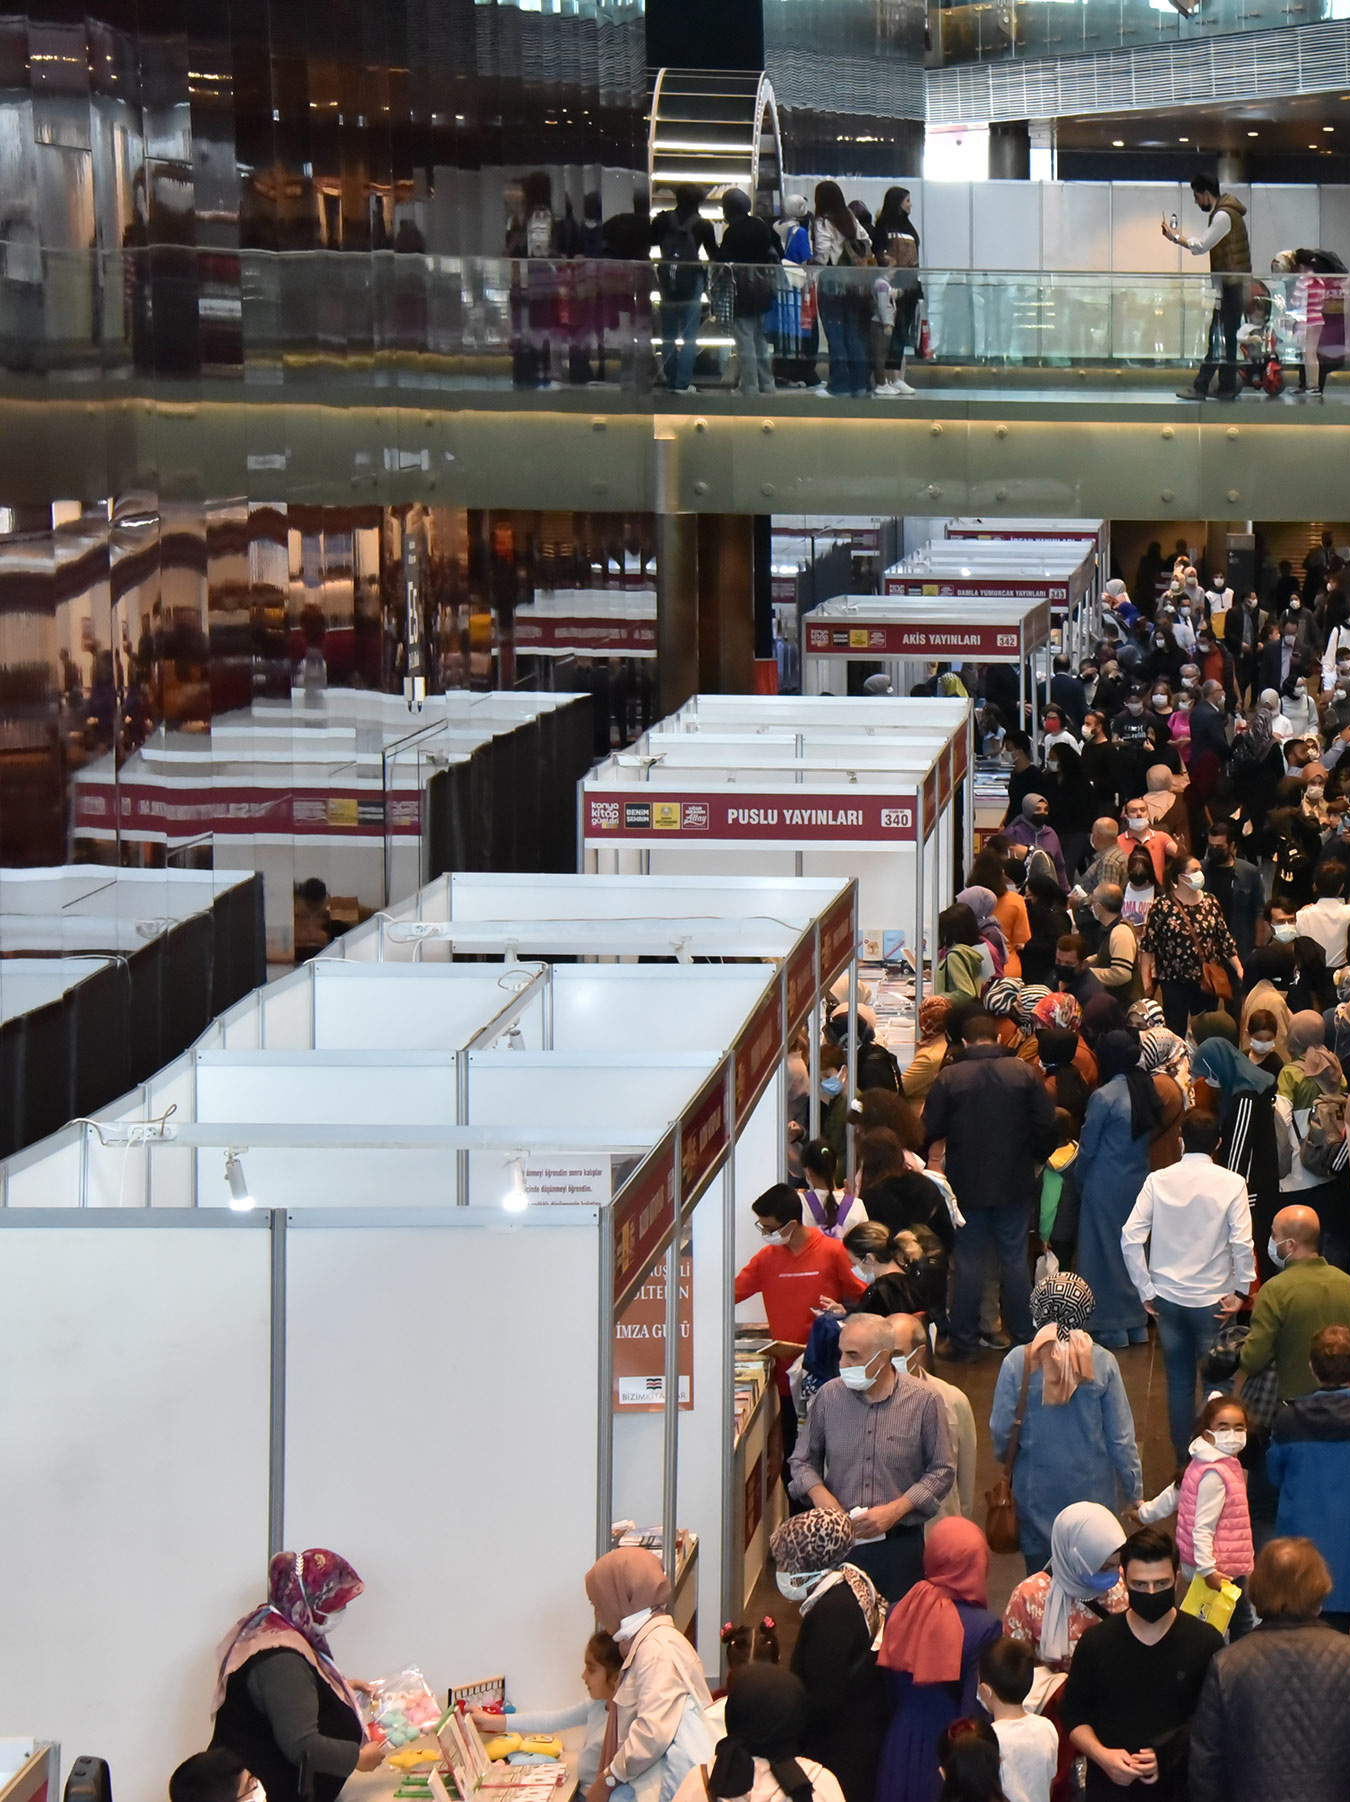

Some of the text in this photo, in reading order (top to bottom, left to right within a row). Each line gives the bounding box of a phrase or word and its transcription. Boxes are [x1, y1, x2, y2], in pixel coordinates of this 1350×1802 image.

[1015, 589, 1046, 597] YAYINLARI
[902, 632, 1015, 646] AKİS YAYINLARI 342
[591, 801, 619, 810] konya
[591, 808, 619, 818] kitap
[727, 809, 908, 826] PUSLU YAYINLARI 340
[616, 1321, 650, 1339] İMZA
